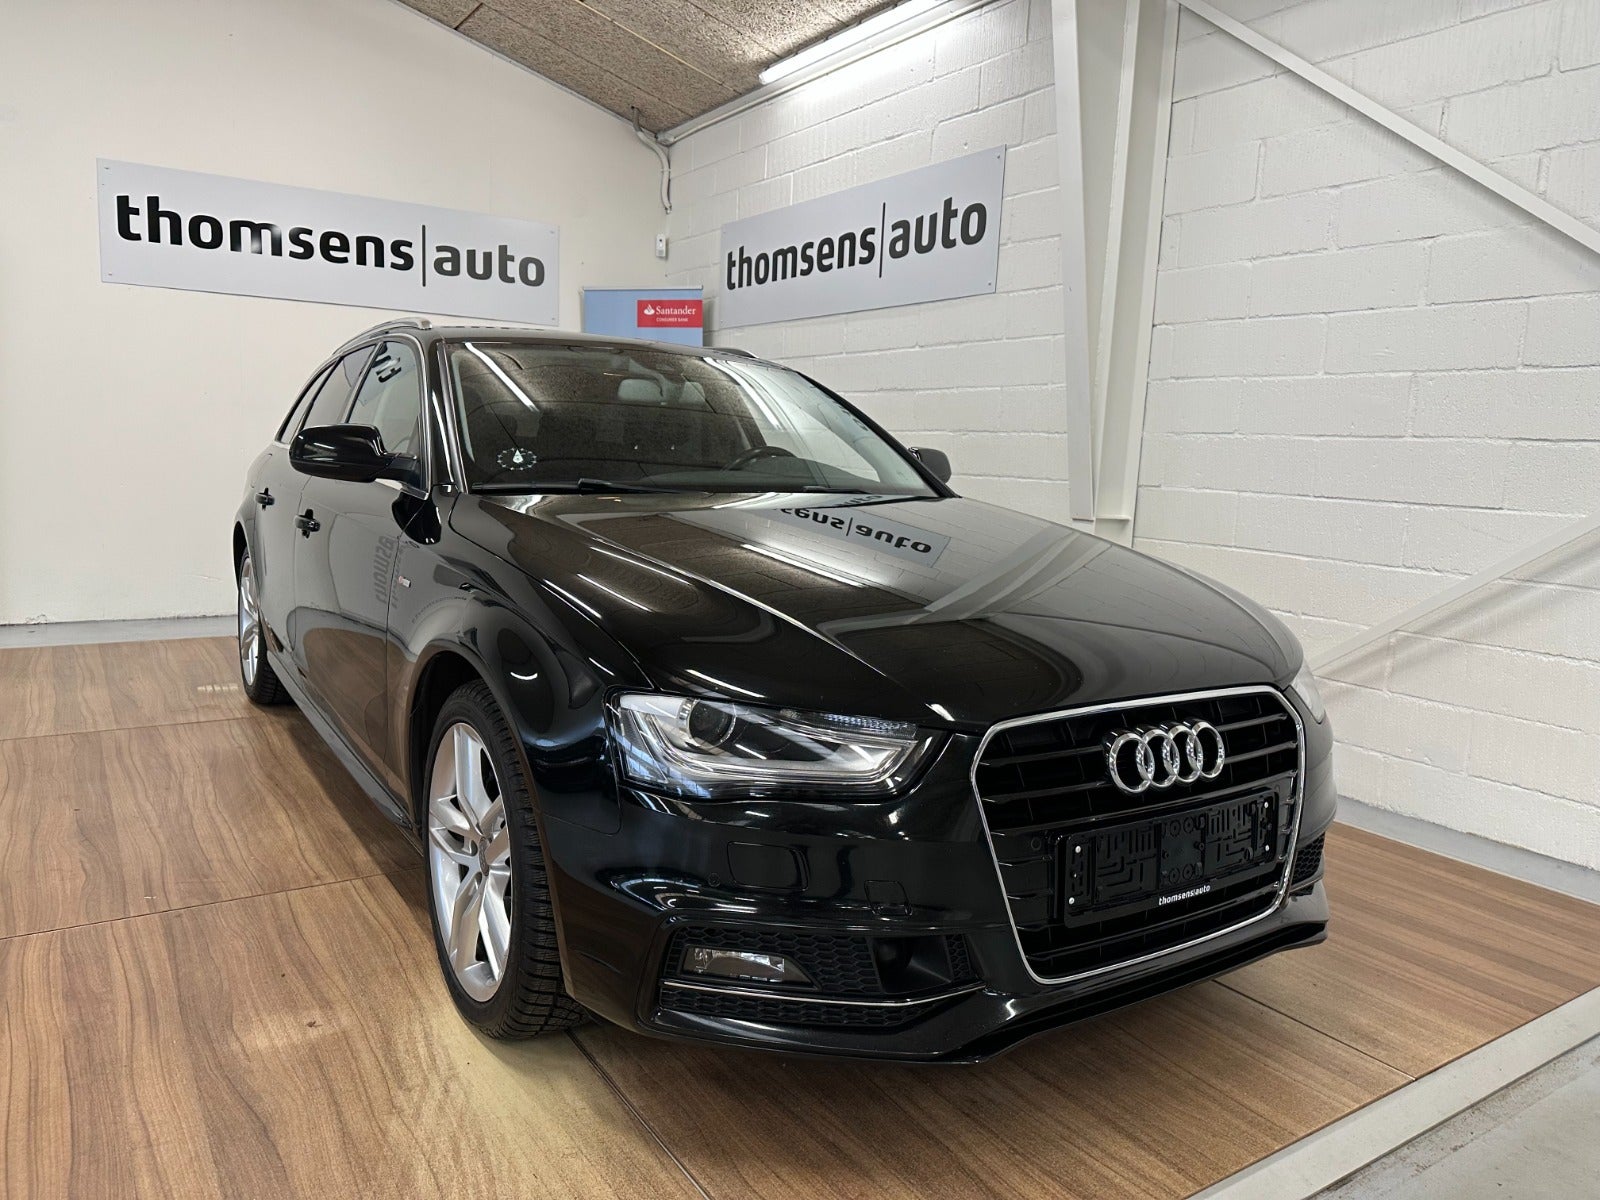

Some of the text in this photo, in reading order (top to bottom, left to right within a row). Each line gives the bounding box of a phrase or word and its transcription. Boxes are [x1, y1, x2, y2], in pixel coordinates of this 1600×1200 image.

[116, 194, 545, 287] thomsens auto
[726, 196, 987, 291] thomsens auto
[655, 305, 697, 315] Santander
